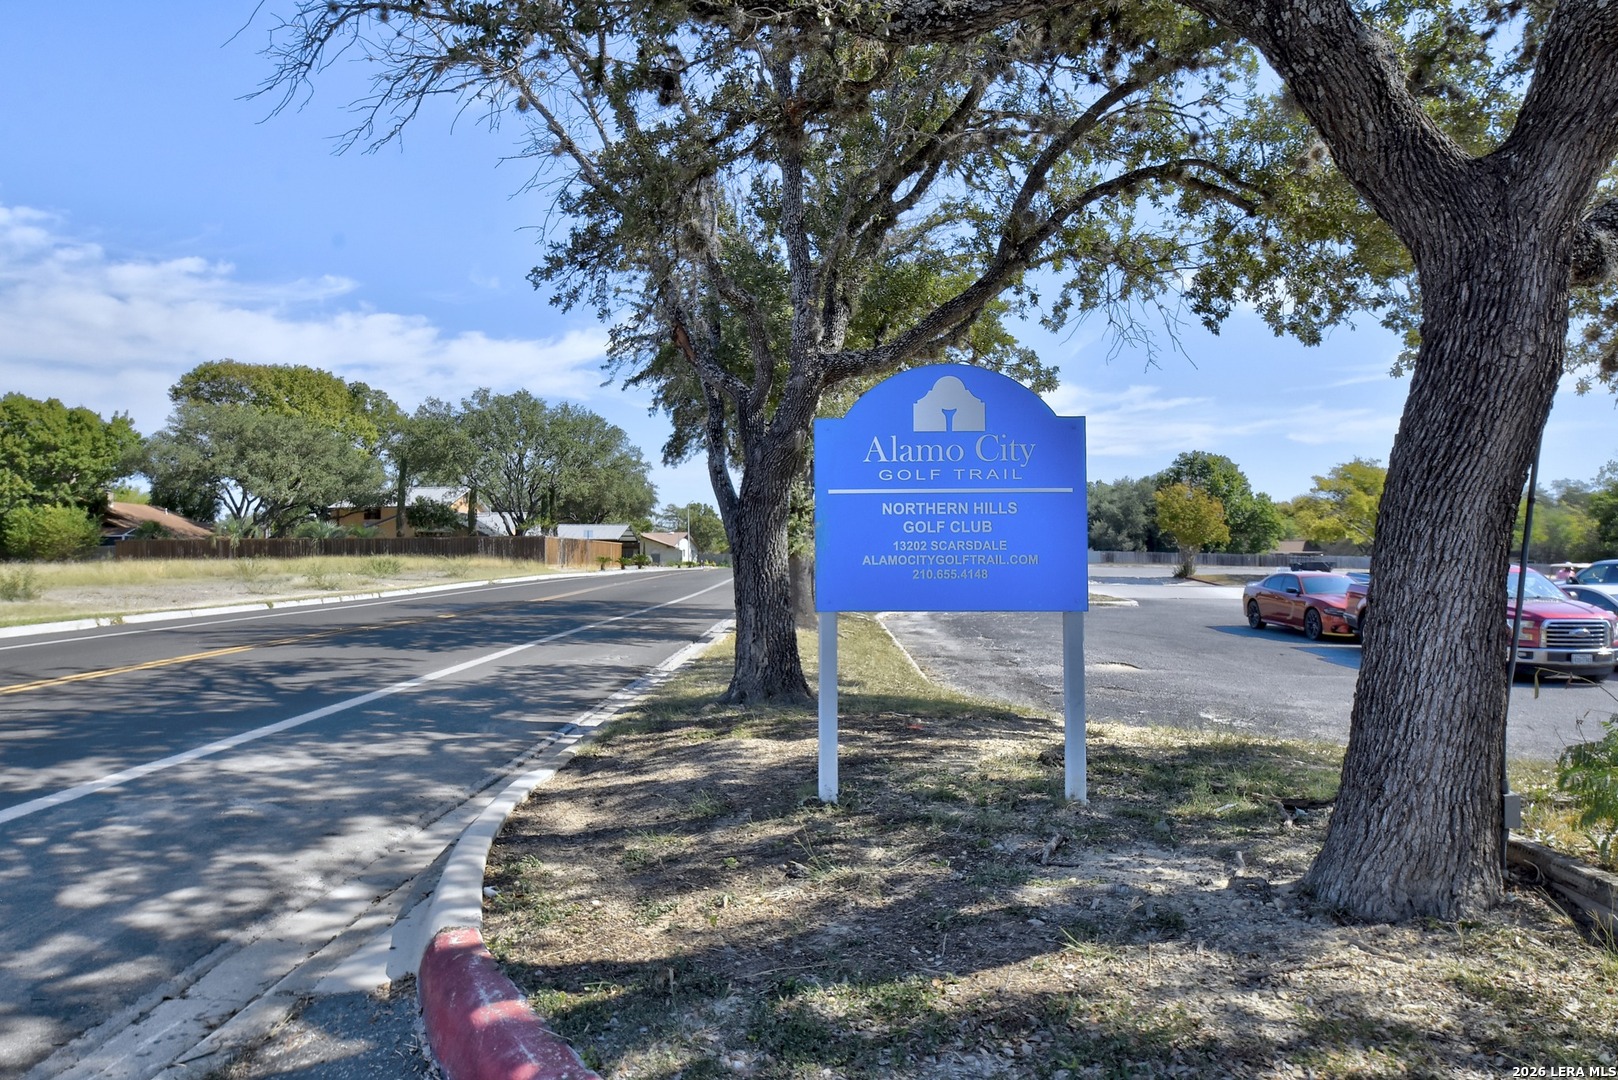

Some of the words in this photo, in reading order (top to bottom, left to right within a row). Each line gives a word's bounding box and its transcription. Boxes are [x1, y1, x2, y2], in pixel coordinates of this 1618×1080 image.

[863, 435, 964, 463] Alamo
[975, 434, 1036, 467] City
[878, 469, 941, 481] GOLF
[953, 468, 1023, 480] TRAIL
[881, 502, 969, 515] NORTHERN
[973, 502, 1018, 514] HILLS
[903, 520, 945, 533] GOLF
[950, 520, 993, 533] CLUB
[893, 541, 927, 551] 13202
[930, 540, 1007, 551] SCARSDALE
[862, 555, 1039, 566] ALAMOCITYGOLFTRAIL.COM
[912, 569, 988, 580] 210.655.4148
